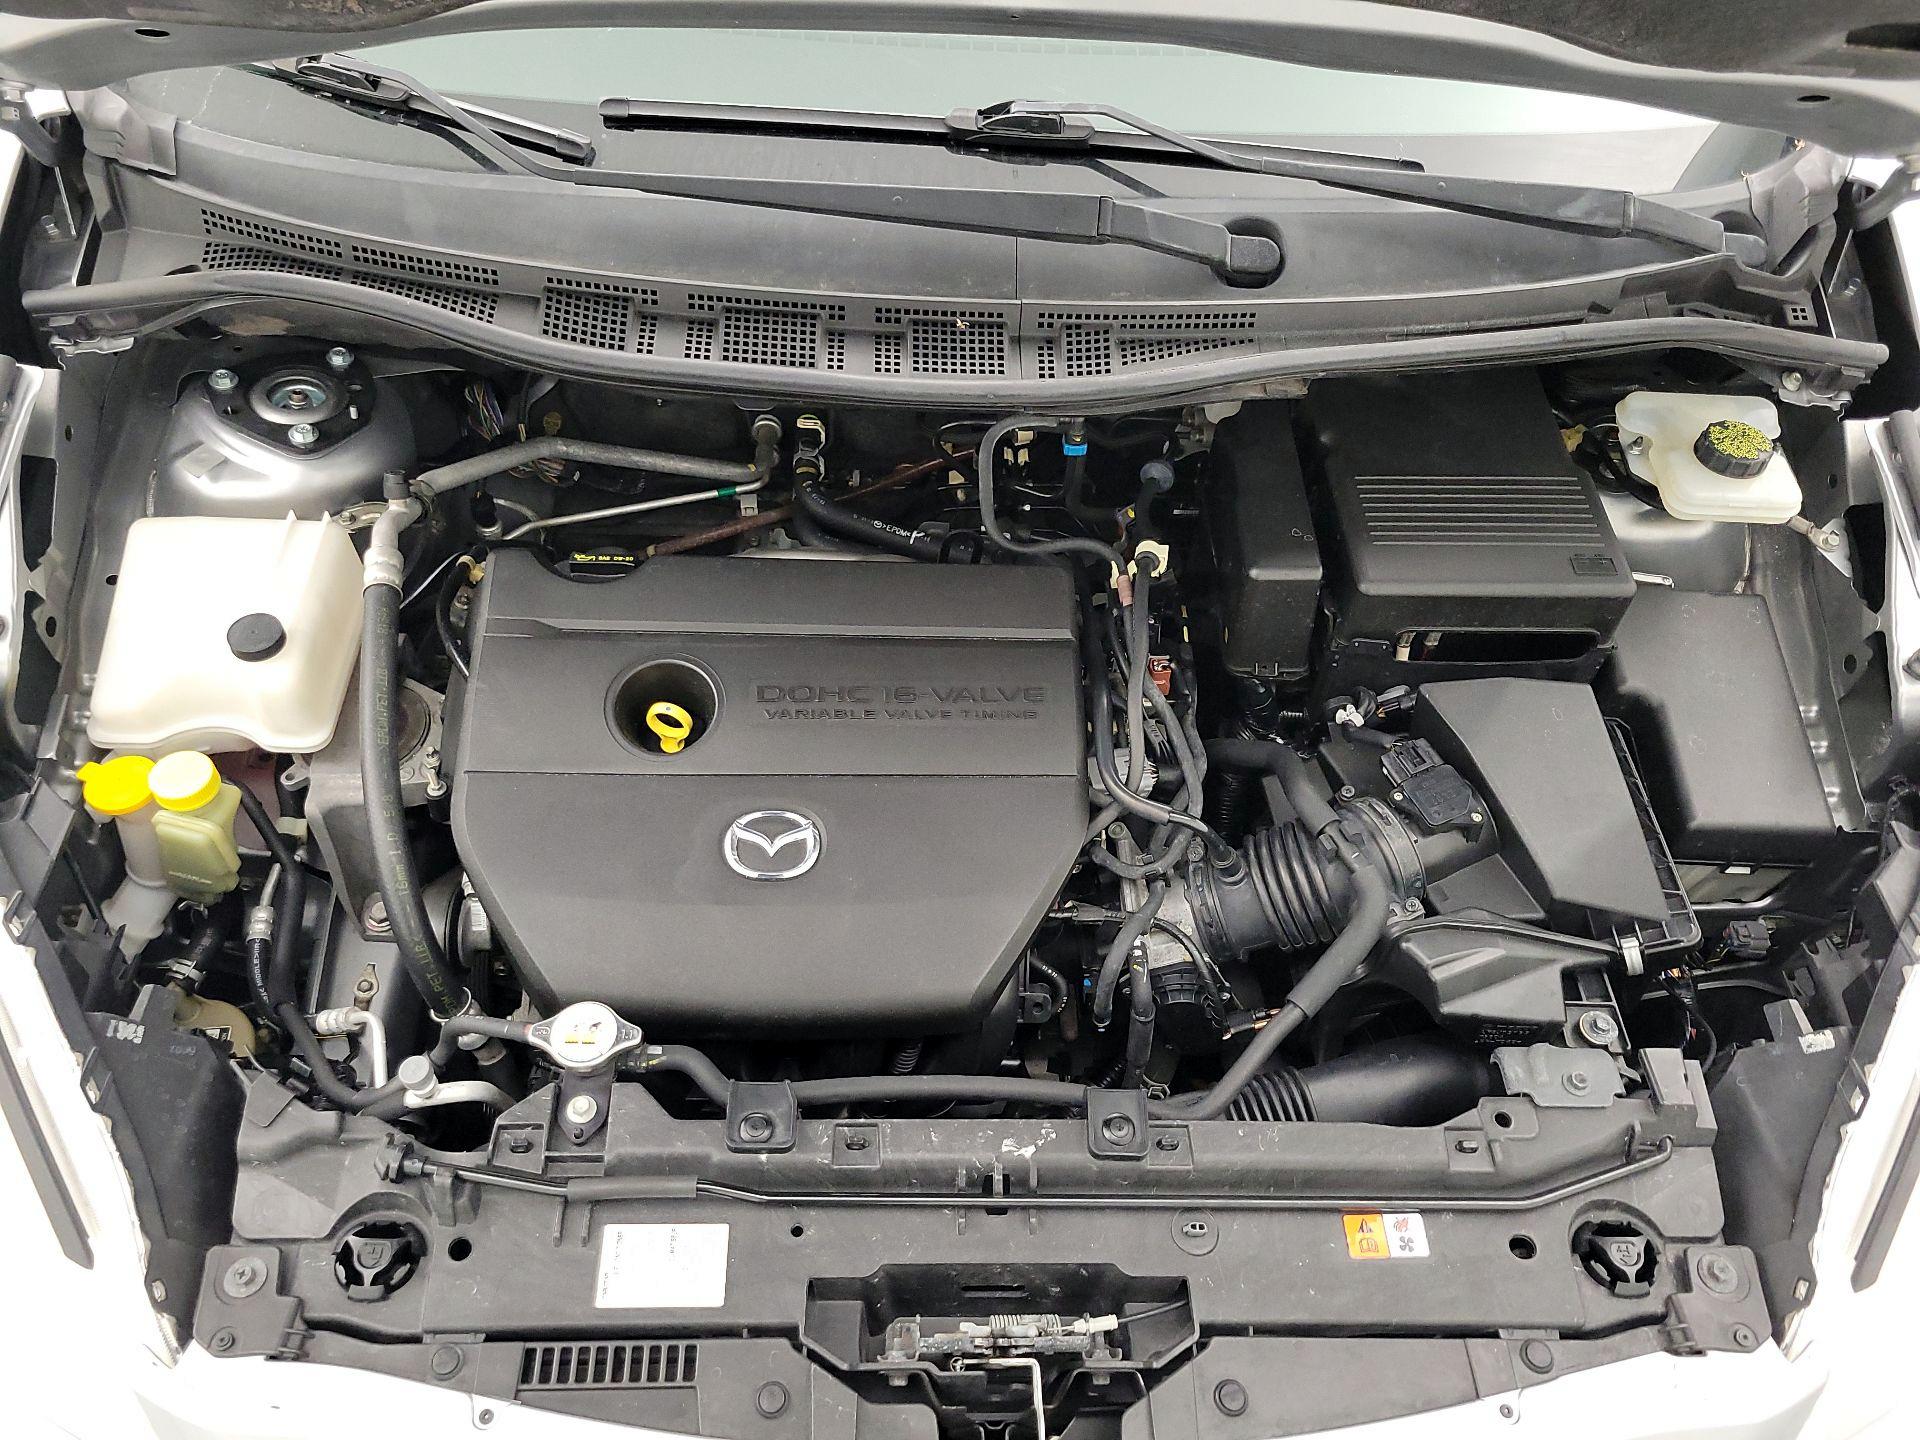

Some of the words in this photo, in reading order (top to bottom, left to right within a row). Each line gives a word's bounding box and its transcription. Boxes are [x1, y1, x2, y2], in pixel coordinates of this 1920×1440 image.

[756, 685, 874, 703] DOHC
[882, 685, 1047, 704] 16-VALVE
[763, 708, 877, 720] VARIABLE
[884, 709, 952, 720] VALVE
[960, 709, 1039, 720] TIMING
